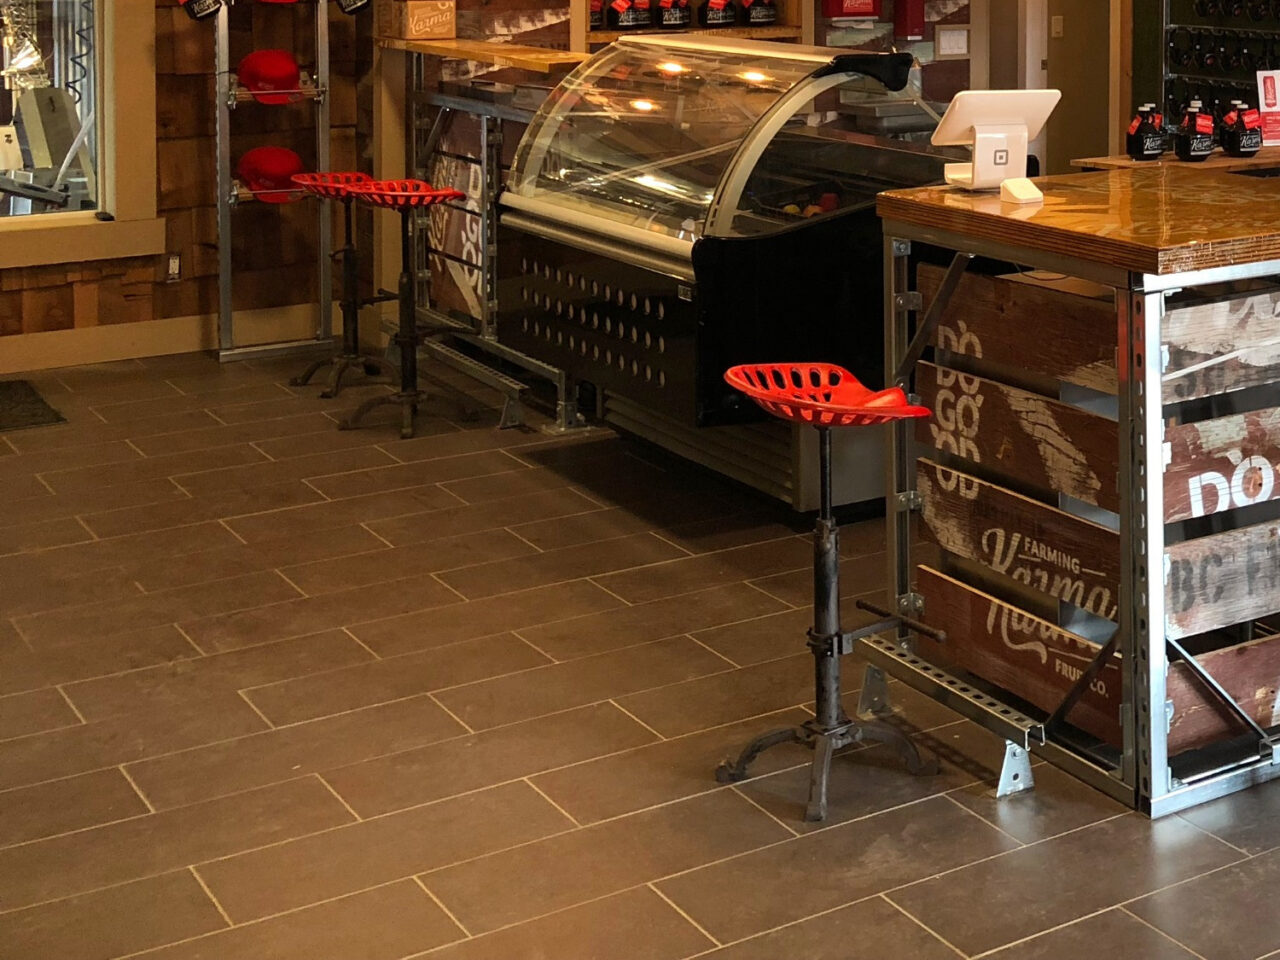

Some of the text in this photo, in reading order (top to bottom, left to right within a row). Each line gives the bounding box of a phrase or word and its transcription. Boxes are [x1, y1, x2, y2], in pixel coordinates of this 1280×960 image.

[409, 11, 451, 35] Karma
[935, 389, 984, 438] GO
[1188, 455, 1275, 518] DO
[1023, 538, 1081, 574] FARMING
[1054, 657, 1084, 683] FRUI
